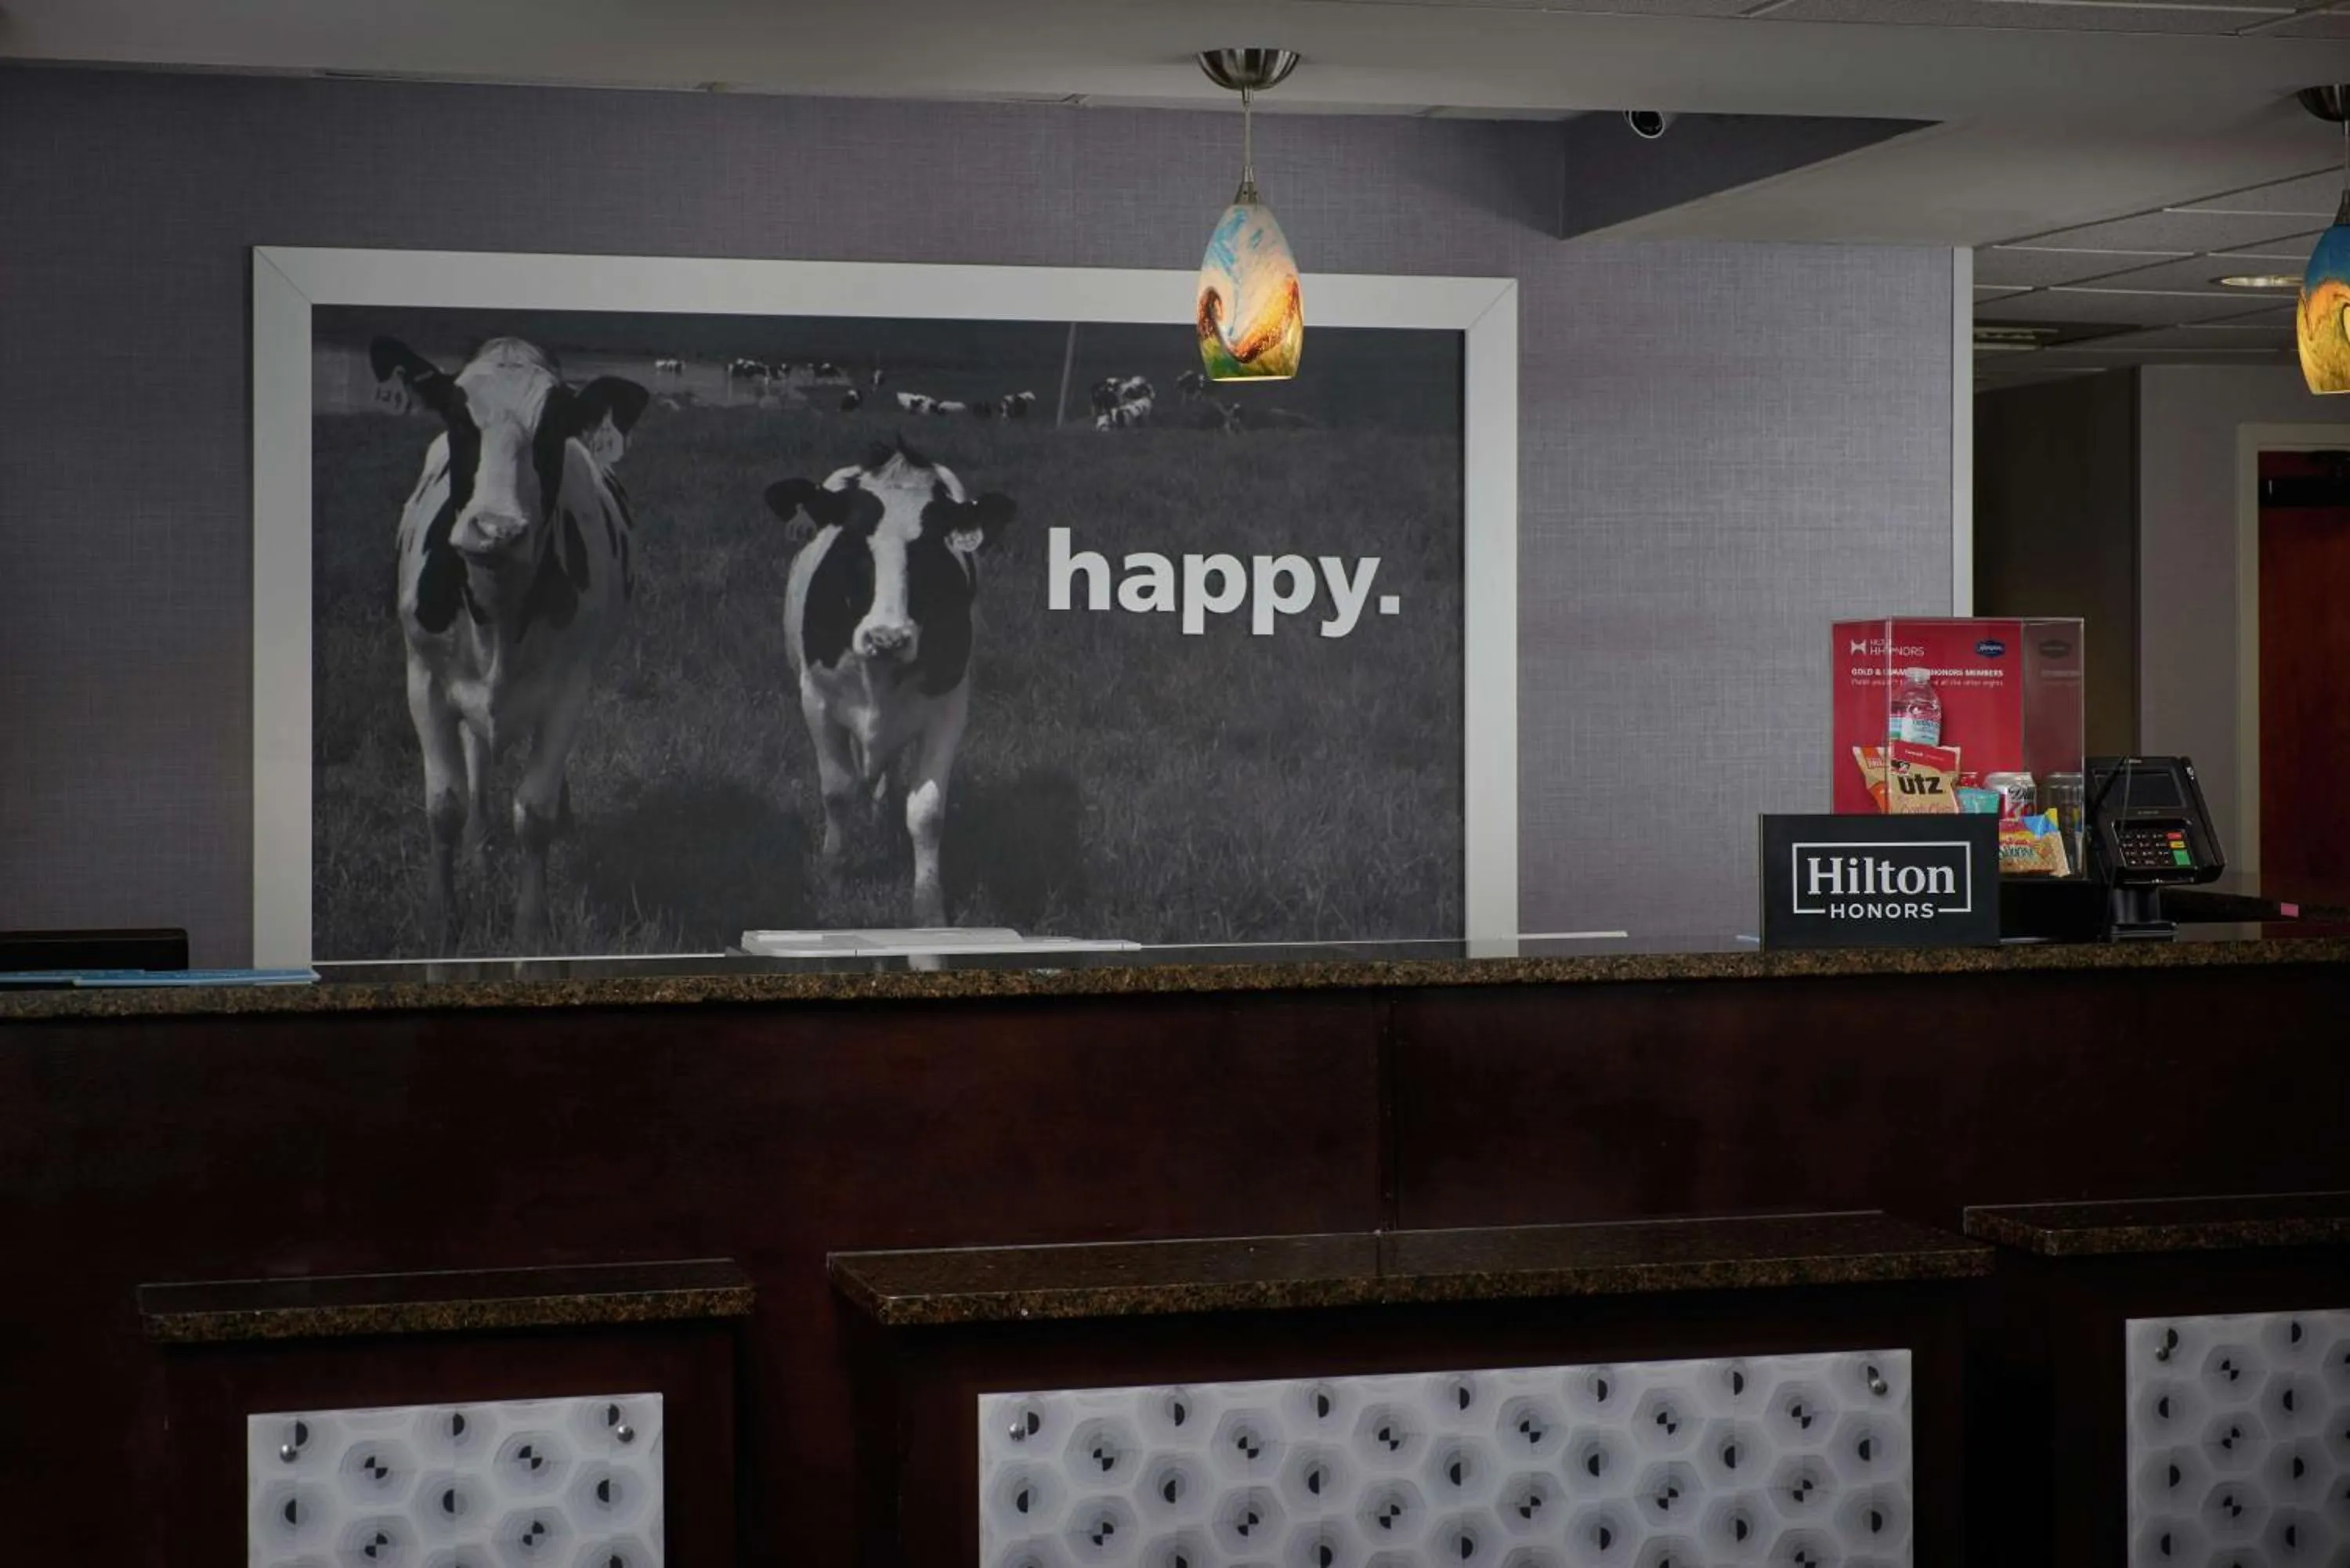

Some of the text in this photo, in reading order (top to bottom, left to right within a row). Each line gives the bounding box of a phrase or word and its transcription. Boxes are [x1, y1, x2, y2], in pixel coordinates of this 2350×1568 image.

[1048, 527, 1400, 638] happy.
[1870, 646, 1925, 656] HHNORS
[1965, 668, 2004, 677] MEMBERS
[1807, 857, 1956, 894] Hilton
[1831, 903, 1934, 919] HONORS
